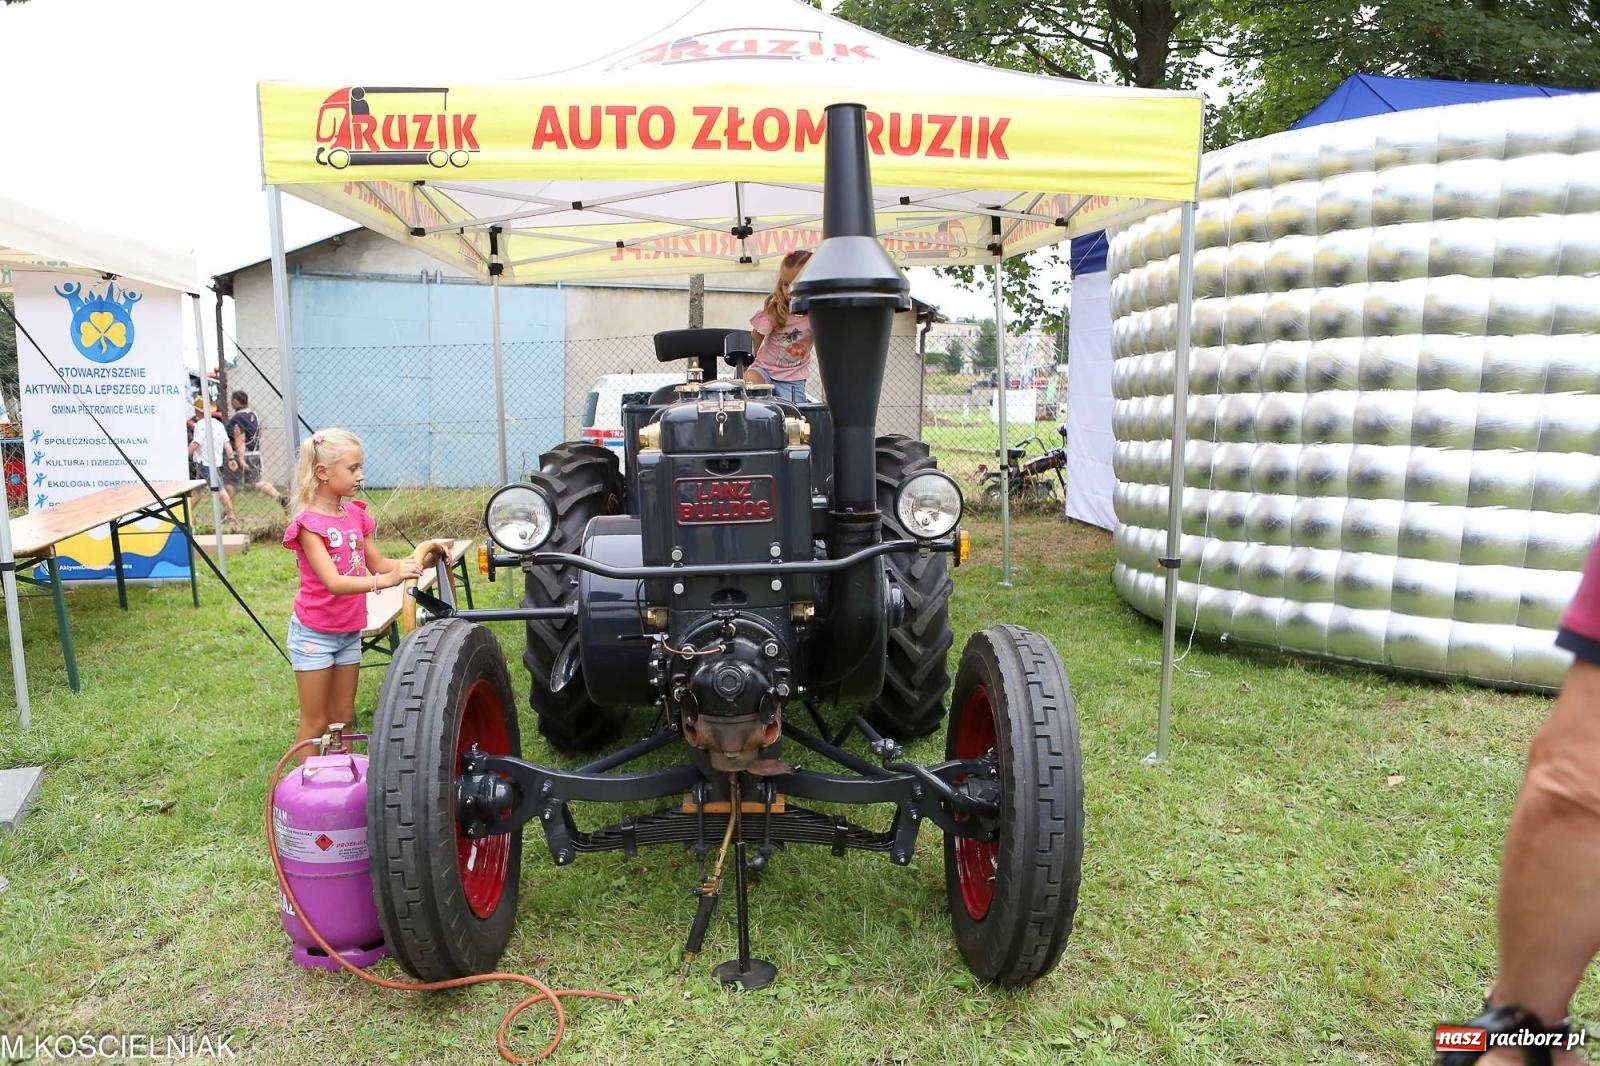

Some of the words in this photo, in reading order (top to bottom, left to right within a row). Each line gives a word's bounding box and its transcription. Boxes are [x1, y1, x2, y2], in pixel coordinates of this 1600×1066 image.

[351, 113, 481, 152] RUZIK
[531, 104, 676, 150] AUTO
[691, 105, 827, 153] ZŁOM
[866, 111, 1011, 160] RUZIK
[58, 367, 146, 378] STOWARZYSZENIE
[25, 384, 71, 395] AKTYWNI
[73, 384, 93, 395] DLA
[95, 384, 146, 395] LEPSZEGO
[149, 384, 180, 395] JUTRA
[51, 405, 77, 415] GMINA
[78, 405, 124, 415] PIETROWICE
[125, 405, 156, 415] WIELKIE
[45, 459, 85, 467] KULTURA
[47, 480, 91, 488] EKOLOGIA
[695, 480, 752, 500] LANZ
[679, 499, 771, 521] BULLDOG
